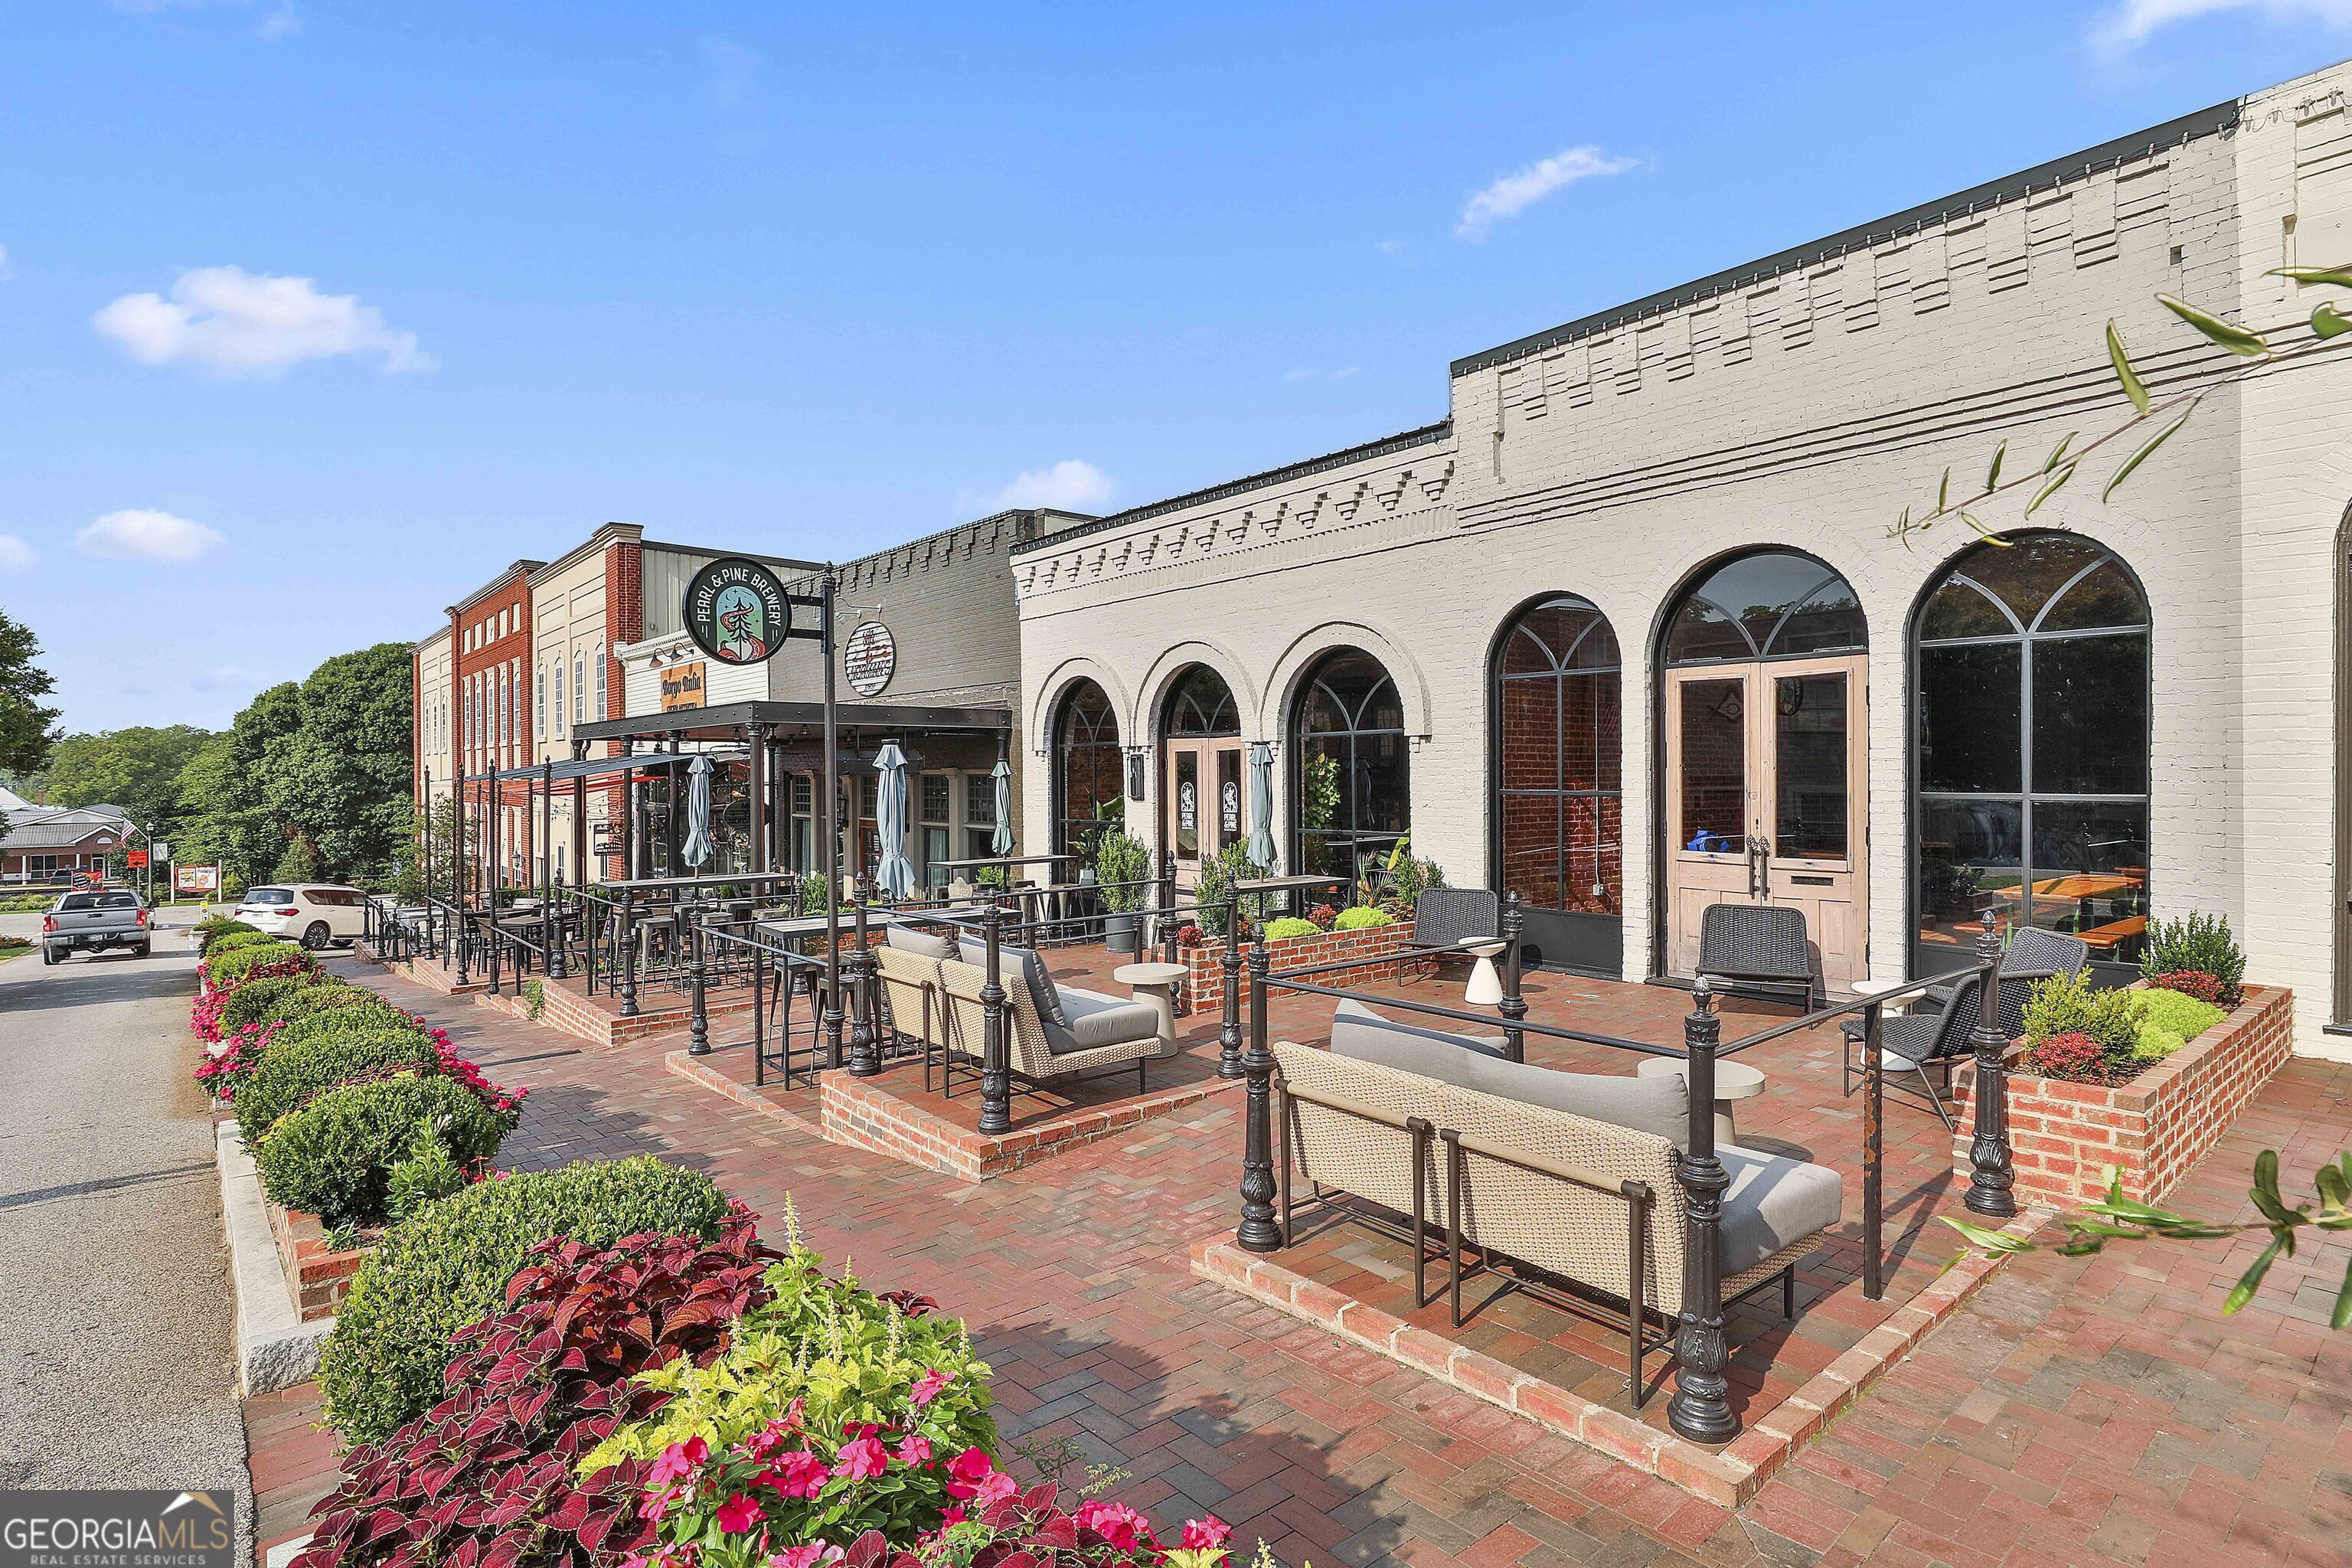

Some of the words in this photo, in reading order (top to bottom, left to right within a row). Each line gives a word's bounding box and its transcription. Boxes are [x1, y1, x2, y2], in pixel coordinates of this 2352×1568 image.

[697, 585, 716, 622] PEARL
[710, 574, 724, 587] &
[721, 567, 750, 583] PINE
[750, 573, 782, 627] BREWERY
[662, 679, 681, 699] Borgo
[682, 671, 701, 692] Italia
[1181, 812, 1194, 820] PEARL
[1223, 813, 1237, 822] PEARL
